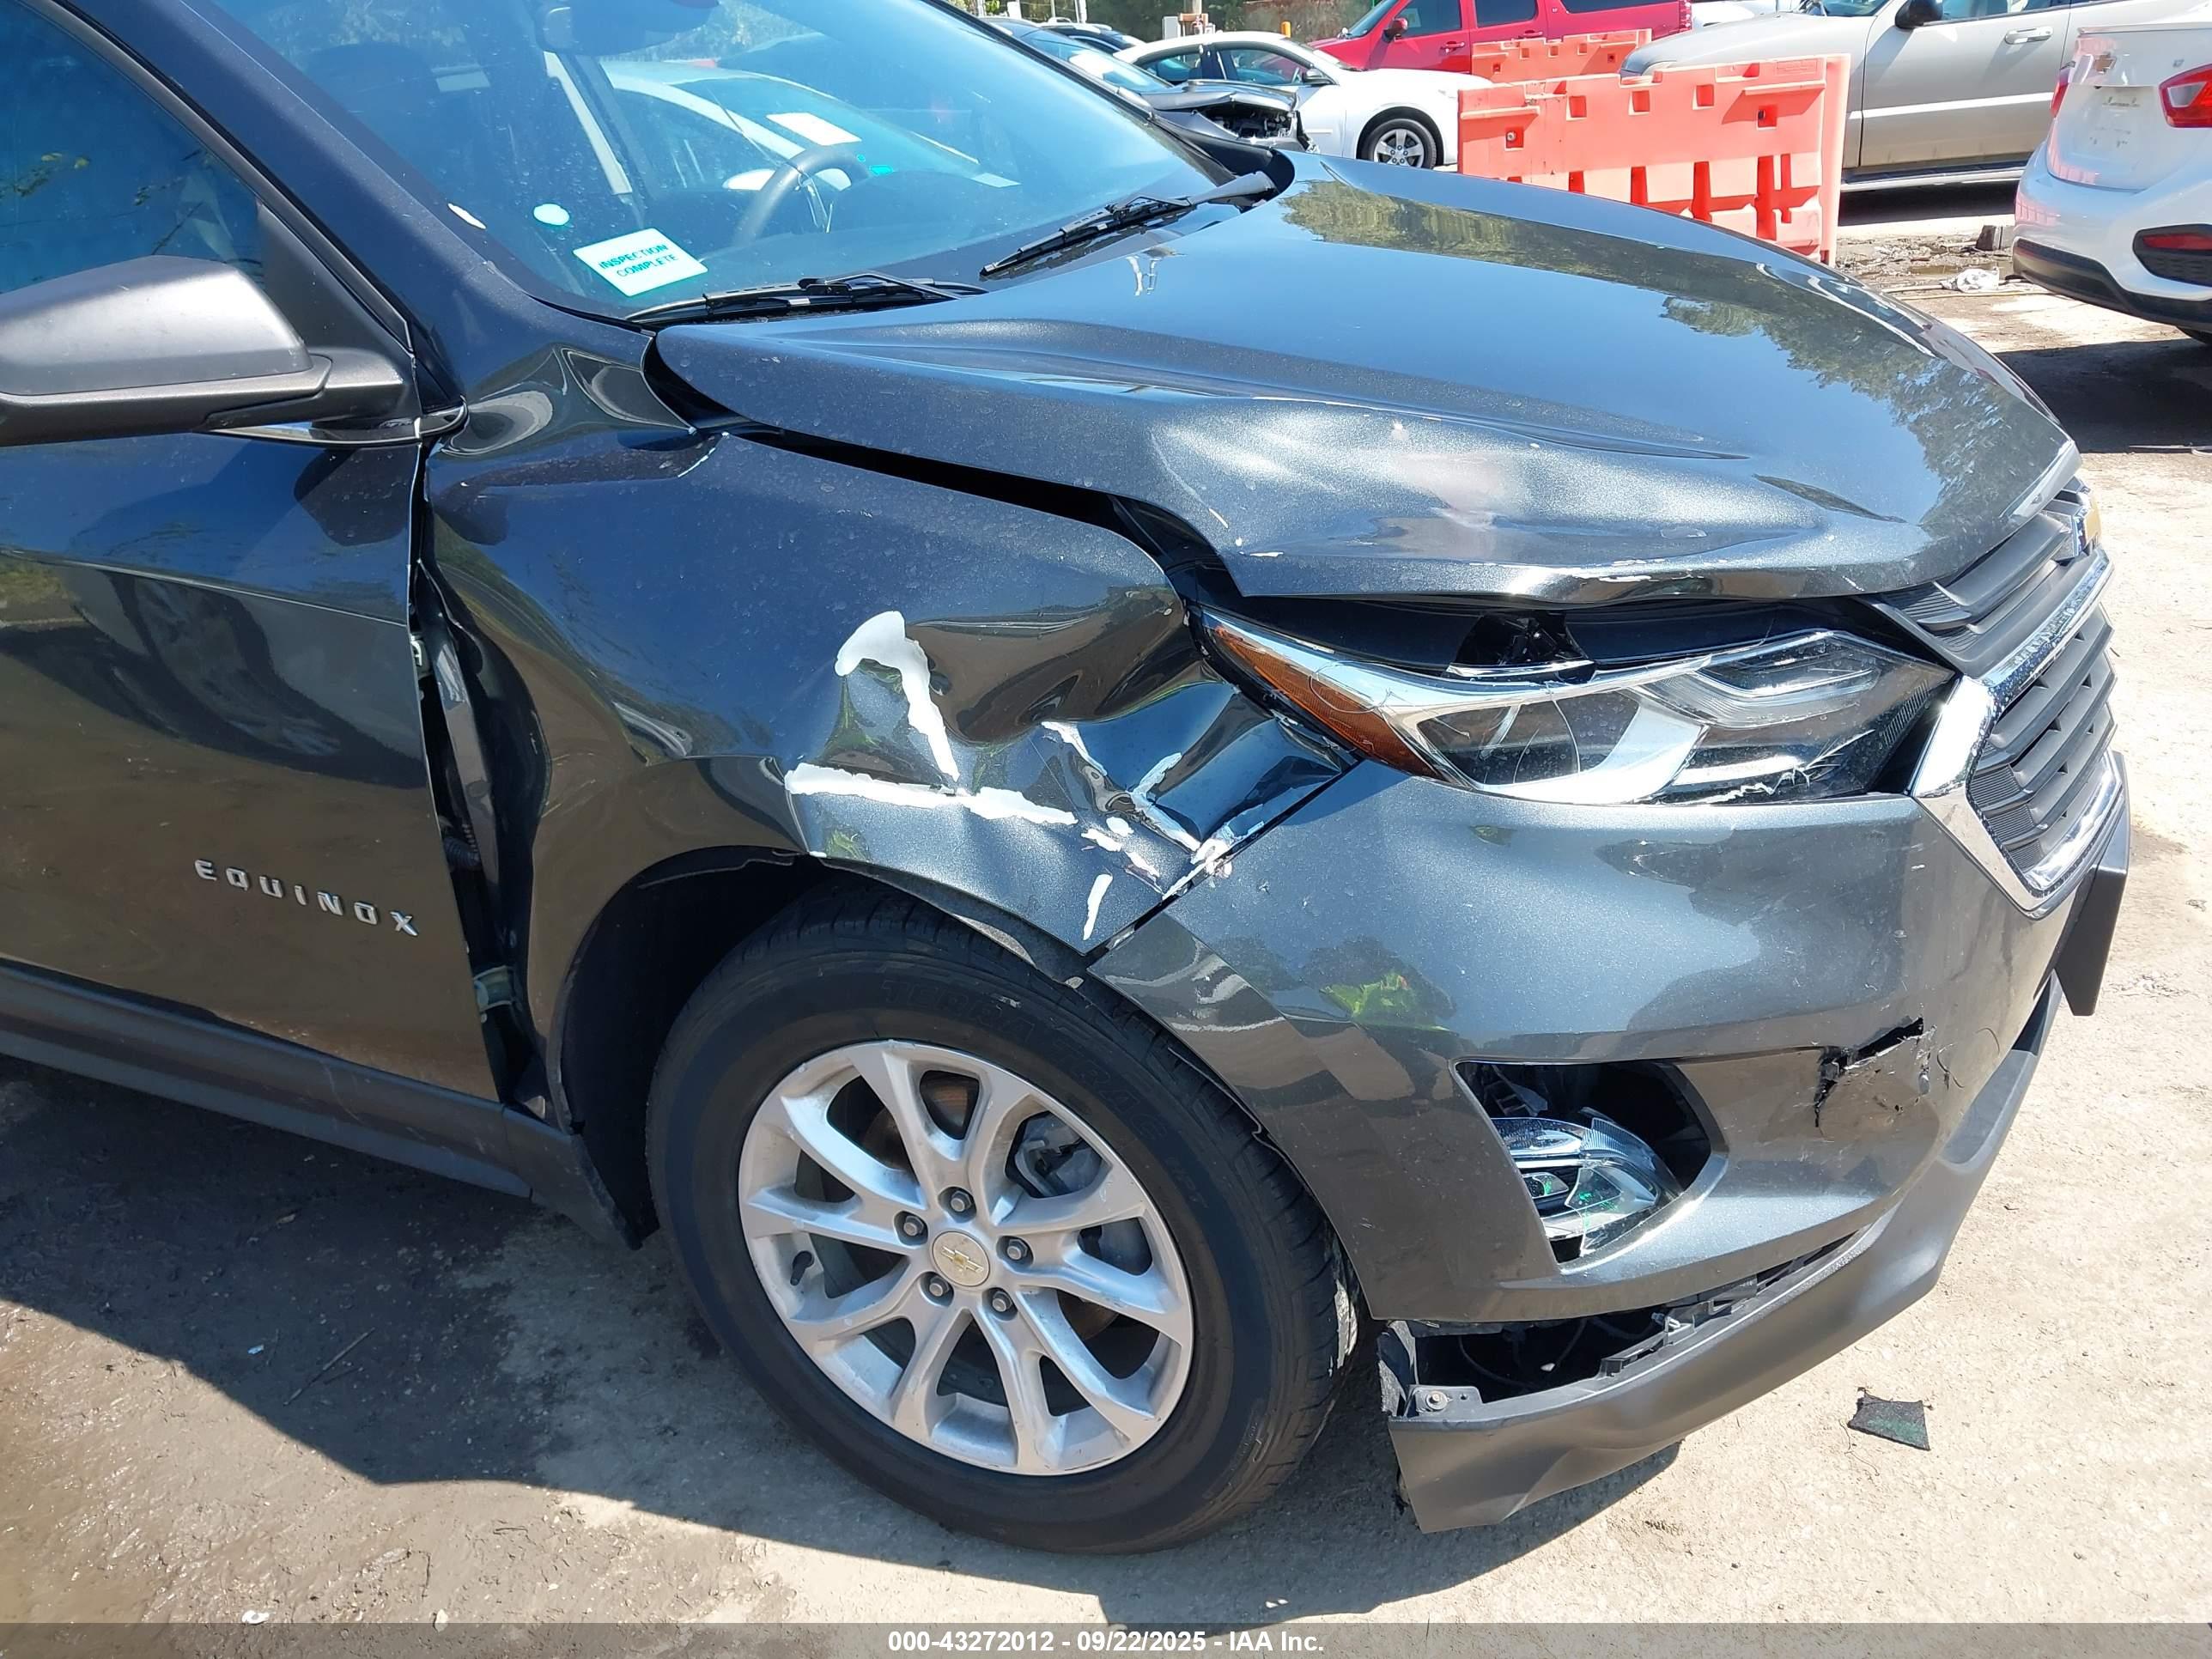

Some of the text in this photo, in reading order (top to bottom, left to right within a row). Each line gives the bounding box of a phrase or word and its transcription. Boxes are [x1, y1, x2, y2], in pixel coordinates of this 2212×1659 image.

[599, 244, 669, 270] INSPECTION
[616, 253, 679, 277] COMPLETE
[194, 860, 419, 937] EQUINOX
